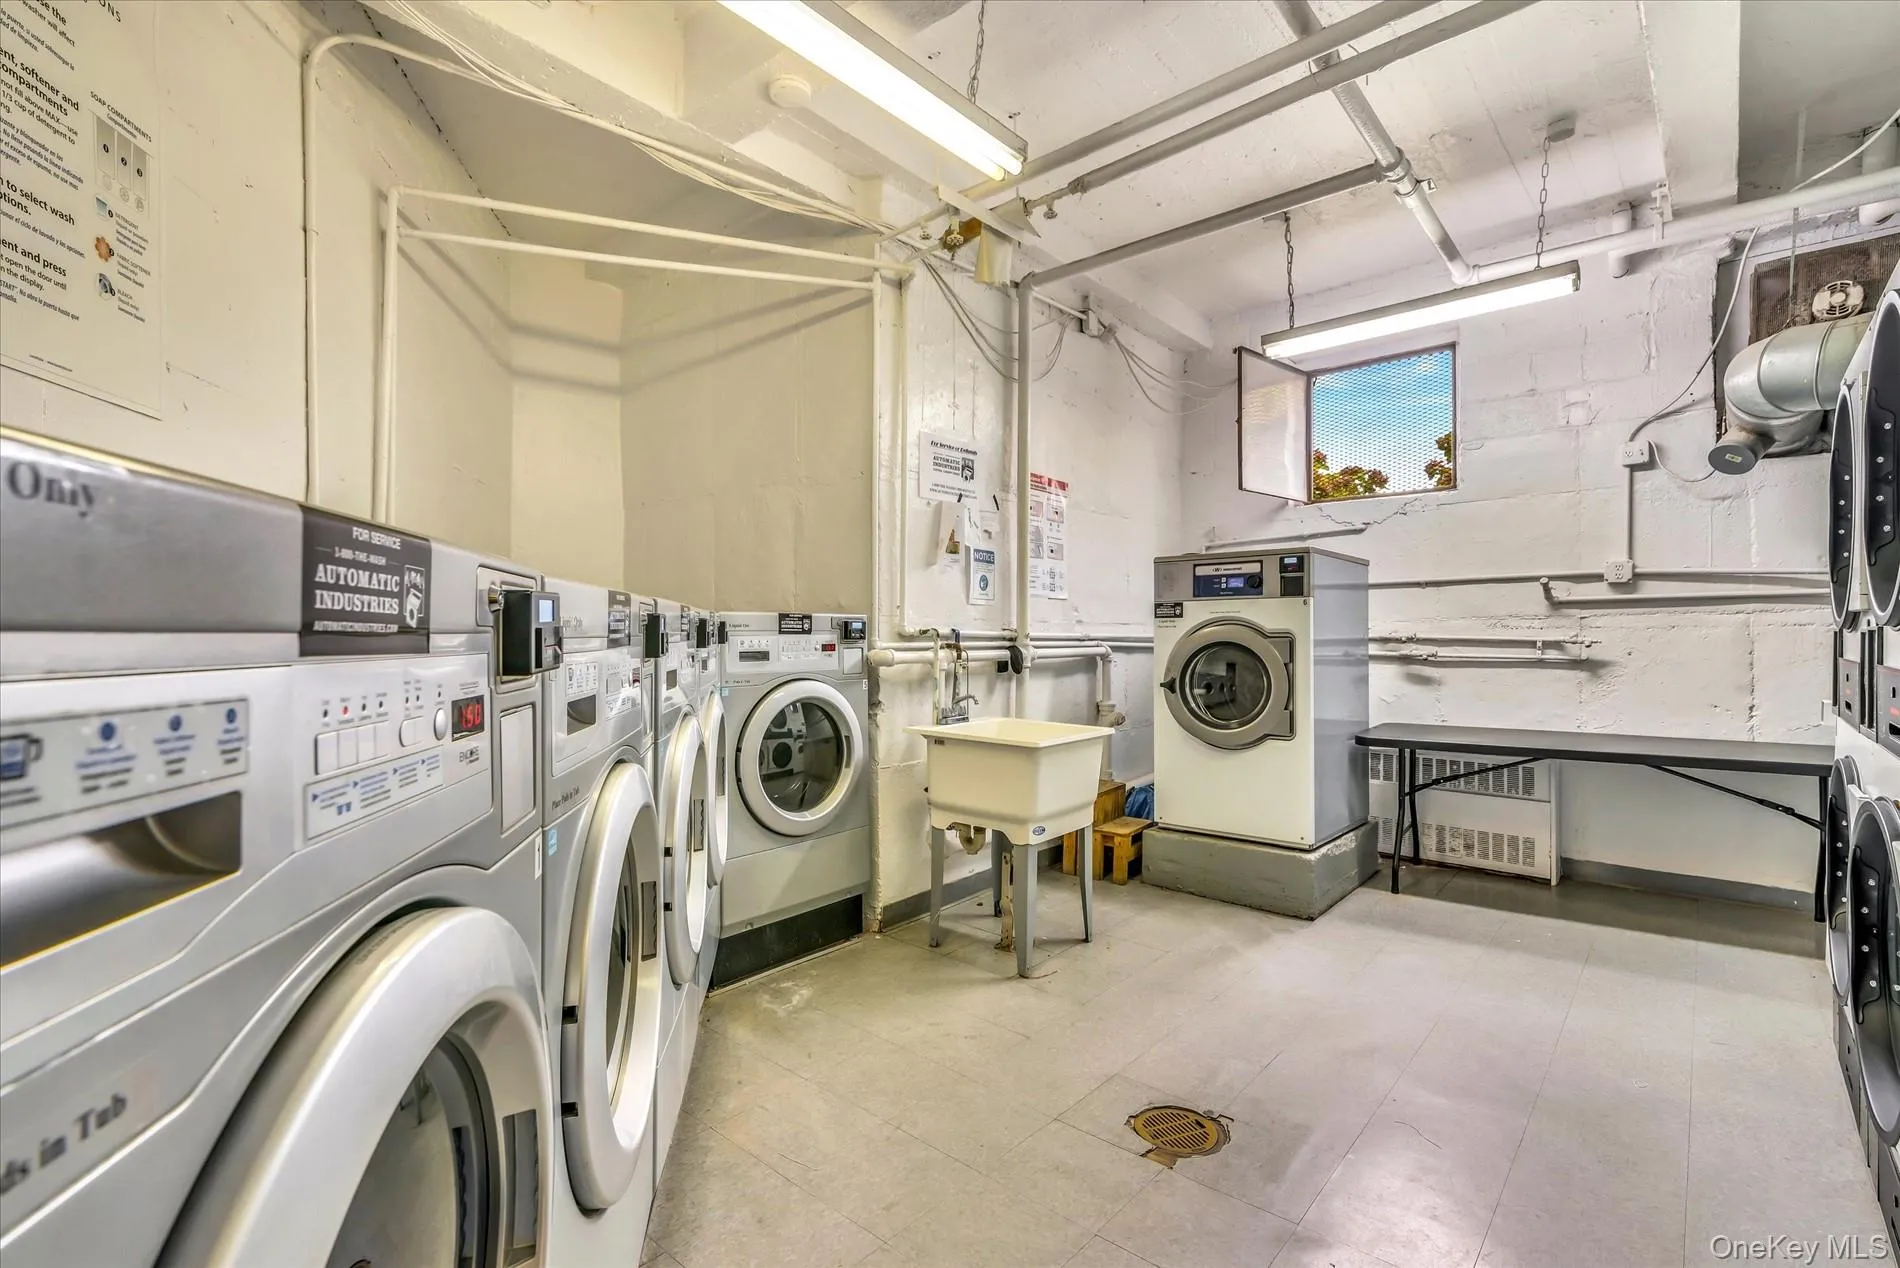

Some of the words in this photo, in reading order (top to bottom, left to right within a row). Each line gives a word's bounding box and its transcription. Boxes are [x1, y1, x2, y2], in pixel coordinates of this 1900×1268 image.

[52, 7, 67, 26] the
[0, 60, 68, 117] ompartments
[20, 62, 60, 97] softener
[62, 93, 79, 112] and
[14, 99, 26, 112] cup
[27, 109, 35, 118] of
[36, 115, 67, 141] detergent
[68, 136, 76, 145] to
[90, 91, 106, 106] SOAP
[107, 104, 152, 143] COMPARTMENTS
[6, 179, 17, 193] to
[19, 188, 48, 212] select
[50, 205, 75, 226] wash
[0, 238, 19, 254] ent
[20, 248, 40, 264] and
[42, 258, 67, 277] press
[5, 256, 24, 271] open
[24, 264, 36, 277] the
[37, 271, 53, 284] door
[6, 267, 19, 279] the
[353, 526, 369, 542] FOR
[370, 530, 401, 550] SERVICE
[975, 551, 994, 563] NOTICE
[315, 563, 400, 592] AUTOMATIC
[314, 589, 400, 614] INDUSTRIES
